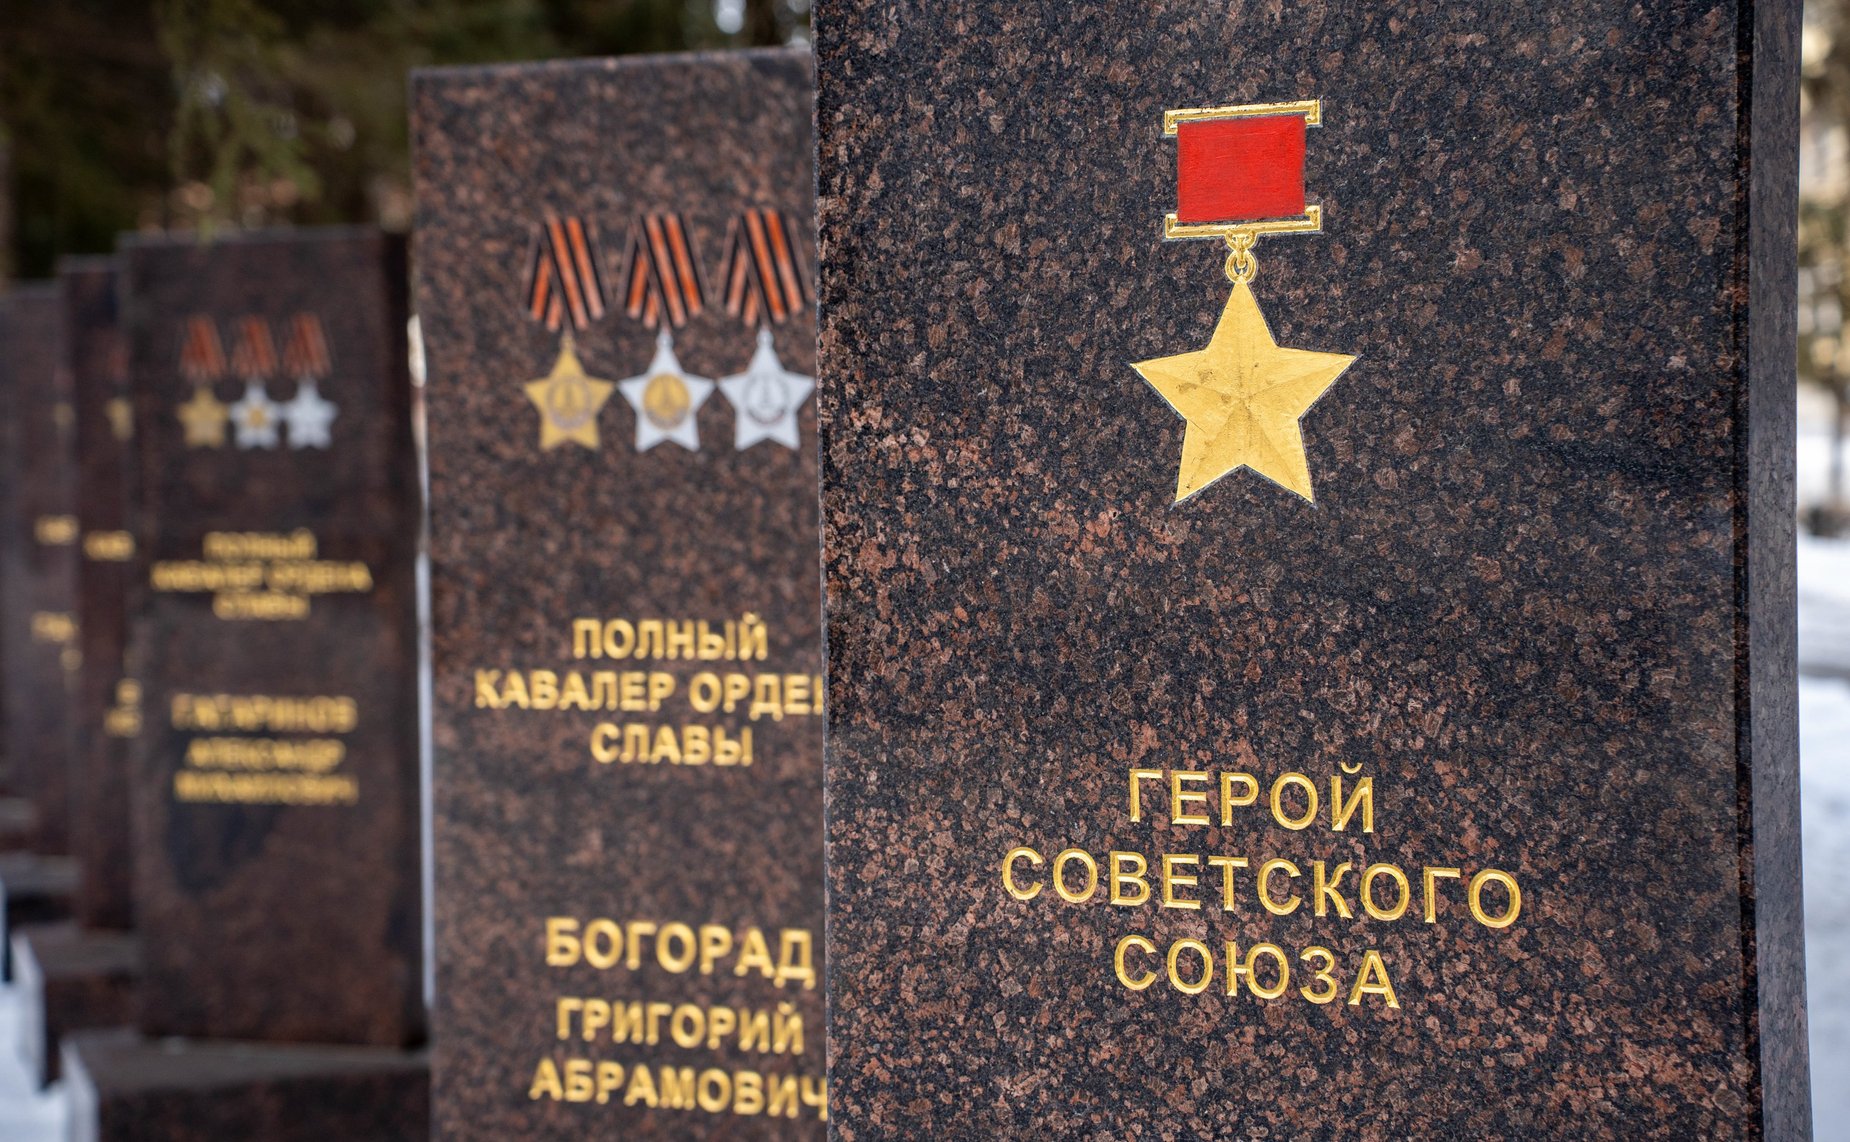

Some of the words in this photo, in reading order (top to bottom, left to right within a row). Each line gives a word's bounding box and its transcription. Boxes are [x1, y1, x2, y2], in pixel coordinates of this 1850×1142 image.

[572, 611, 768, 661] ПОЛНЫЙ
[474, 669, 676, 712] КАВАЛЕР
[689, 671, 823, 721] ОРДЕ
[590, 722, 754, 766] СЛАВЫ
[1128, 761, 1374, 833] ГЕРОЙ
[1001, 846, 1522, 930] СОВЕТСКОГО
[545, 916, 816, 990] БОГОРАД
[1113, 934, 1401, 1009] СОЮЗА
[556, 997, 805, 1055] ГРИГОРИЙ
[529, 1057, 828, 1121] АБРАМОВИЧ
